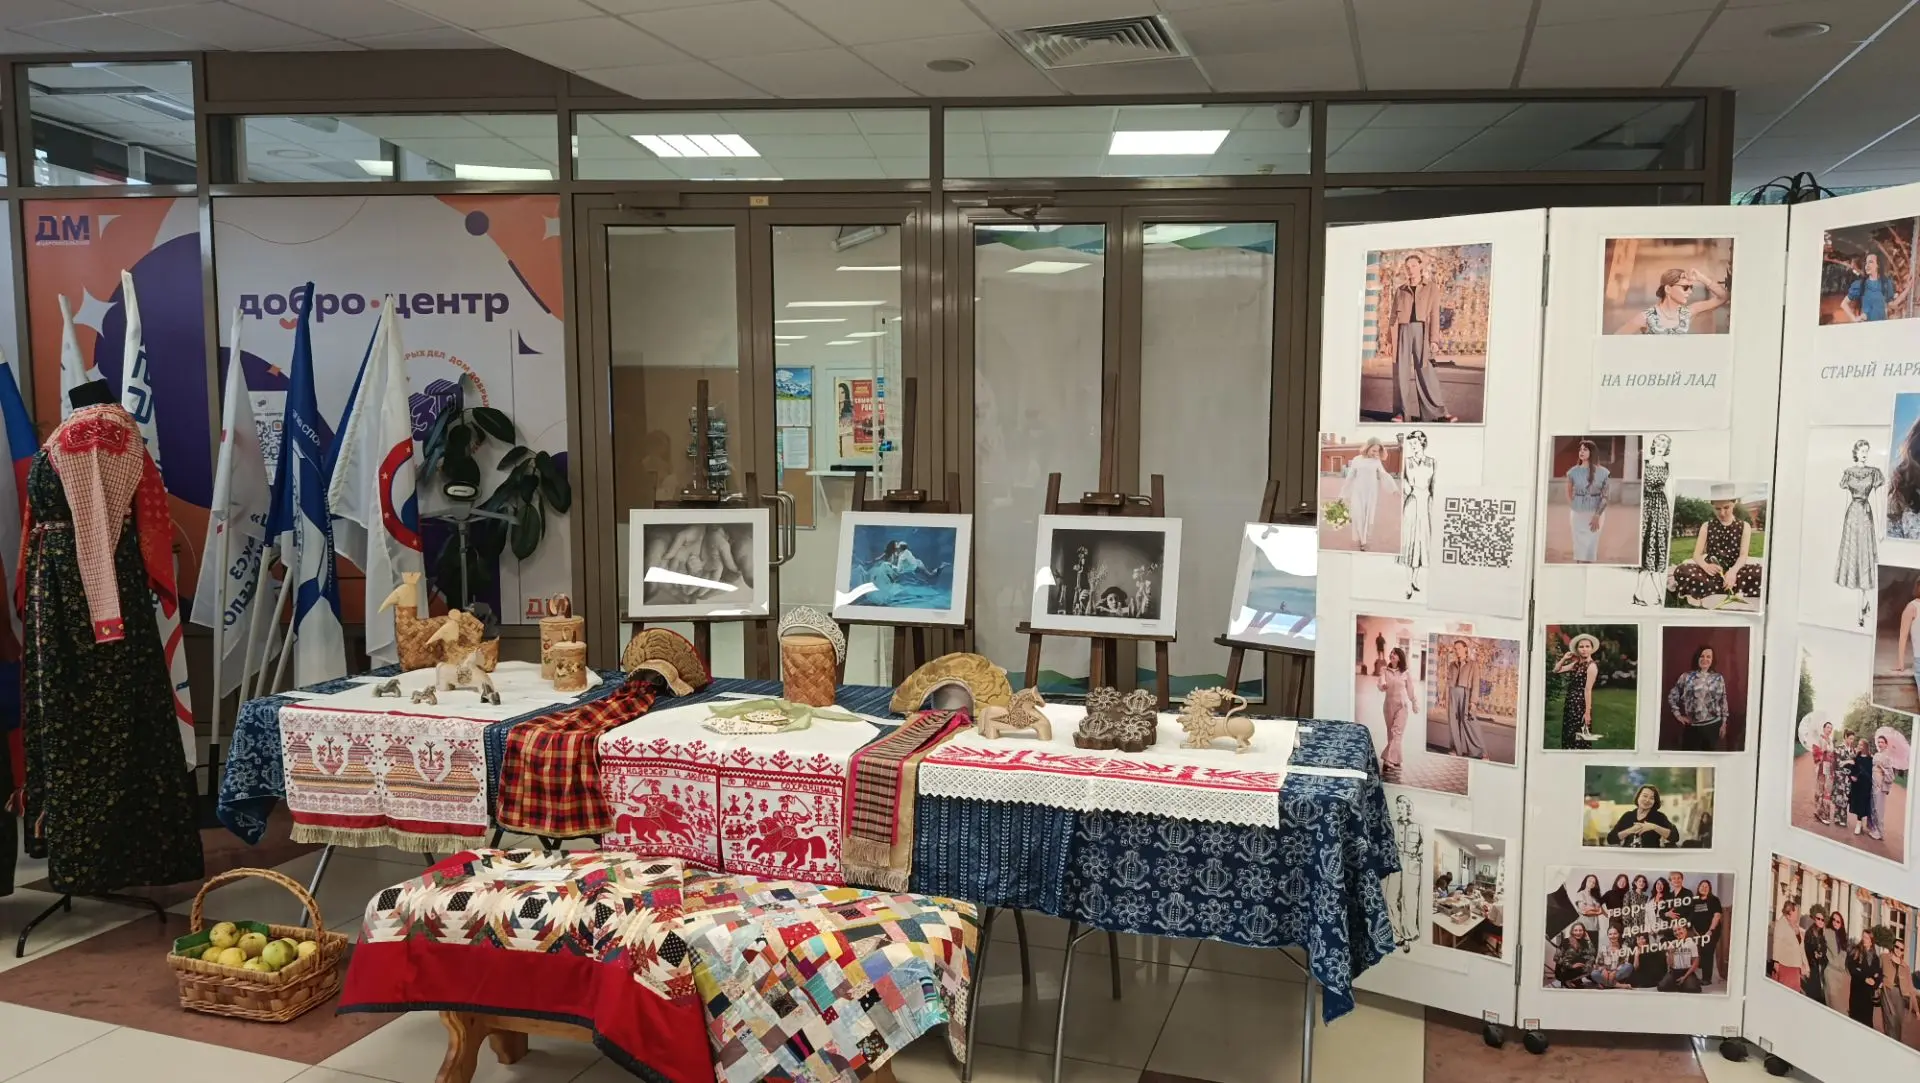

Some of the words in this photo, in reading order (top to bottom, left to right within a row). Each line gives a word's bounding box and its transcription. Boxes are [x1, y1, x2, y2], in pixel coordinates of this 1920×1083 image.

[1600, 374, 1621, 387] НА
[1625, 370, 1682, 387] НОВЫЙ
[1684, 373, 1718, 388] ЛАД
[1820, 361, 1878, 380] СТАРЫЙ
